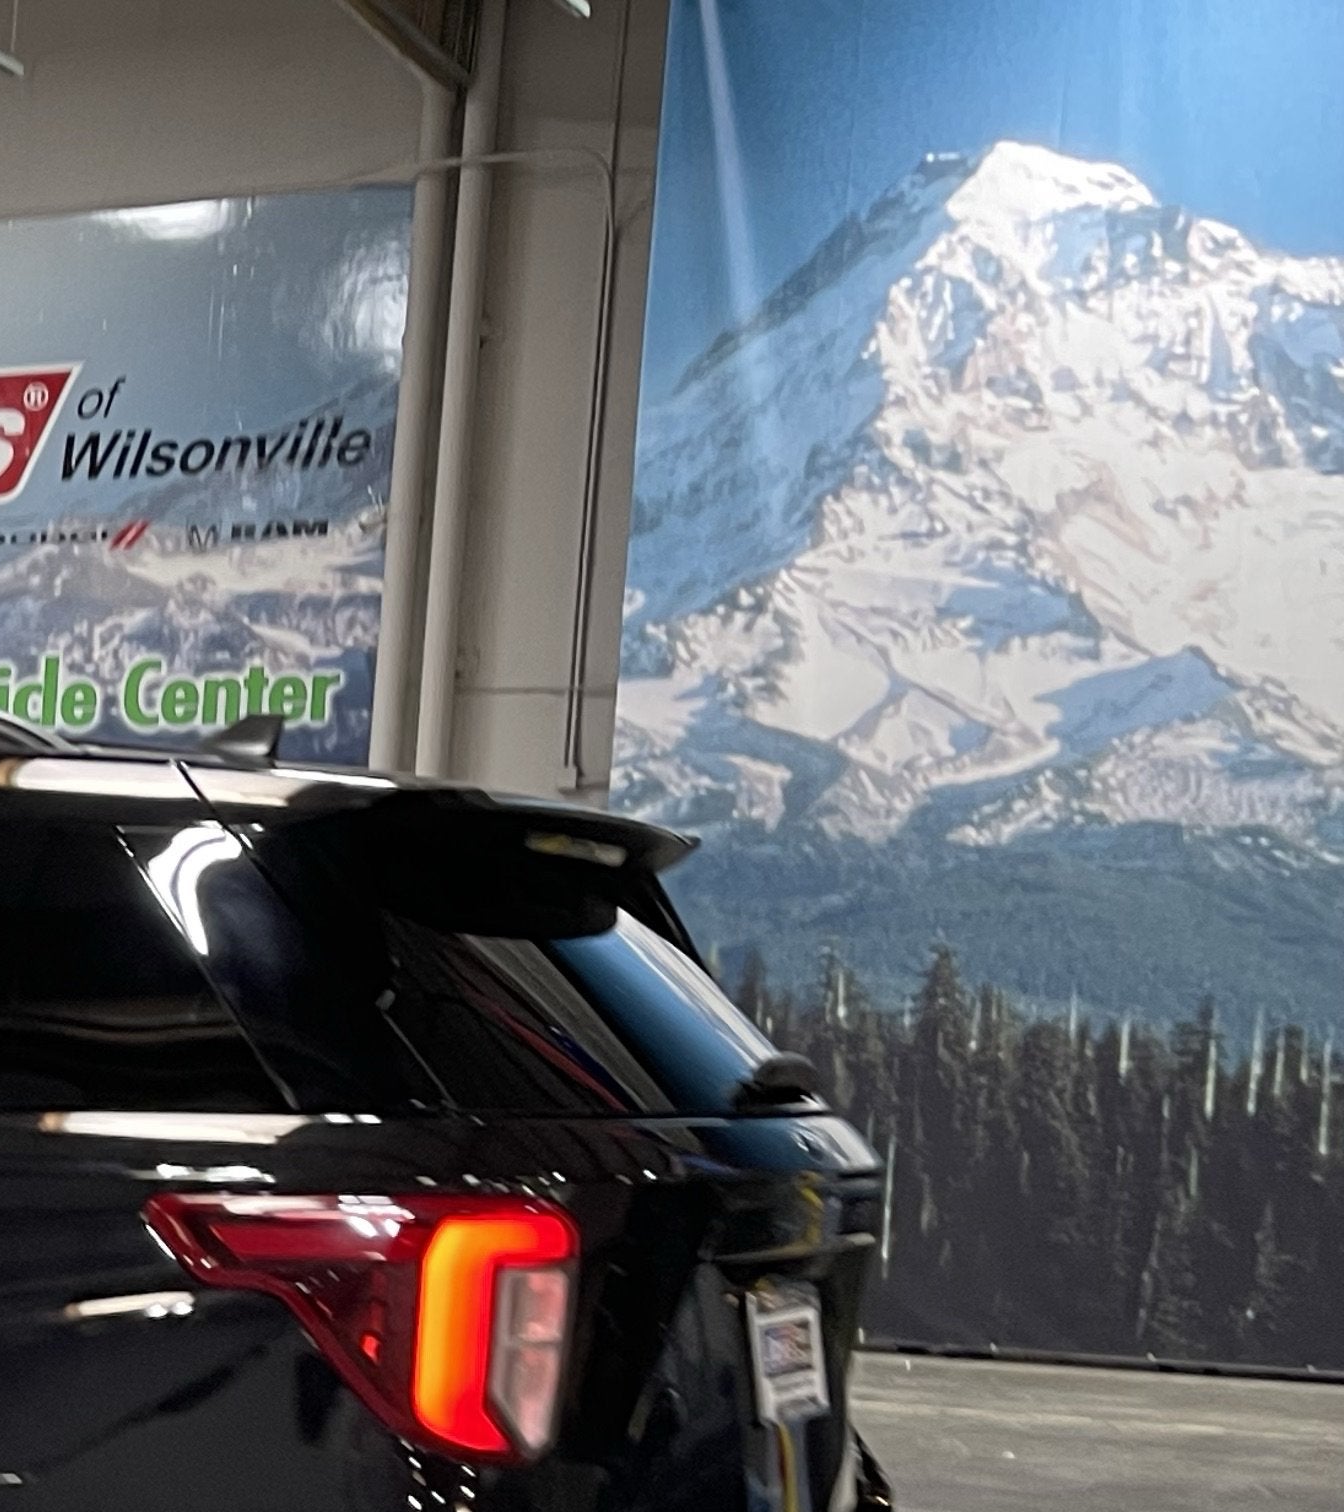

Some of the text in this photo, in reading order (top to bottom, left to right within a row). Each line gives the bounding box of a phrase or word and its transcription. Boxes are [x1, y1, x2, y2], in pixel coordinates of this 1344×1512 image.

[77, 376, 125, 420] of
[62, 415, 371, 481] Wilsonville
[124, 656, 340, 727] Center
